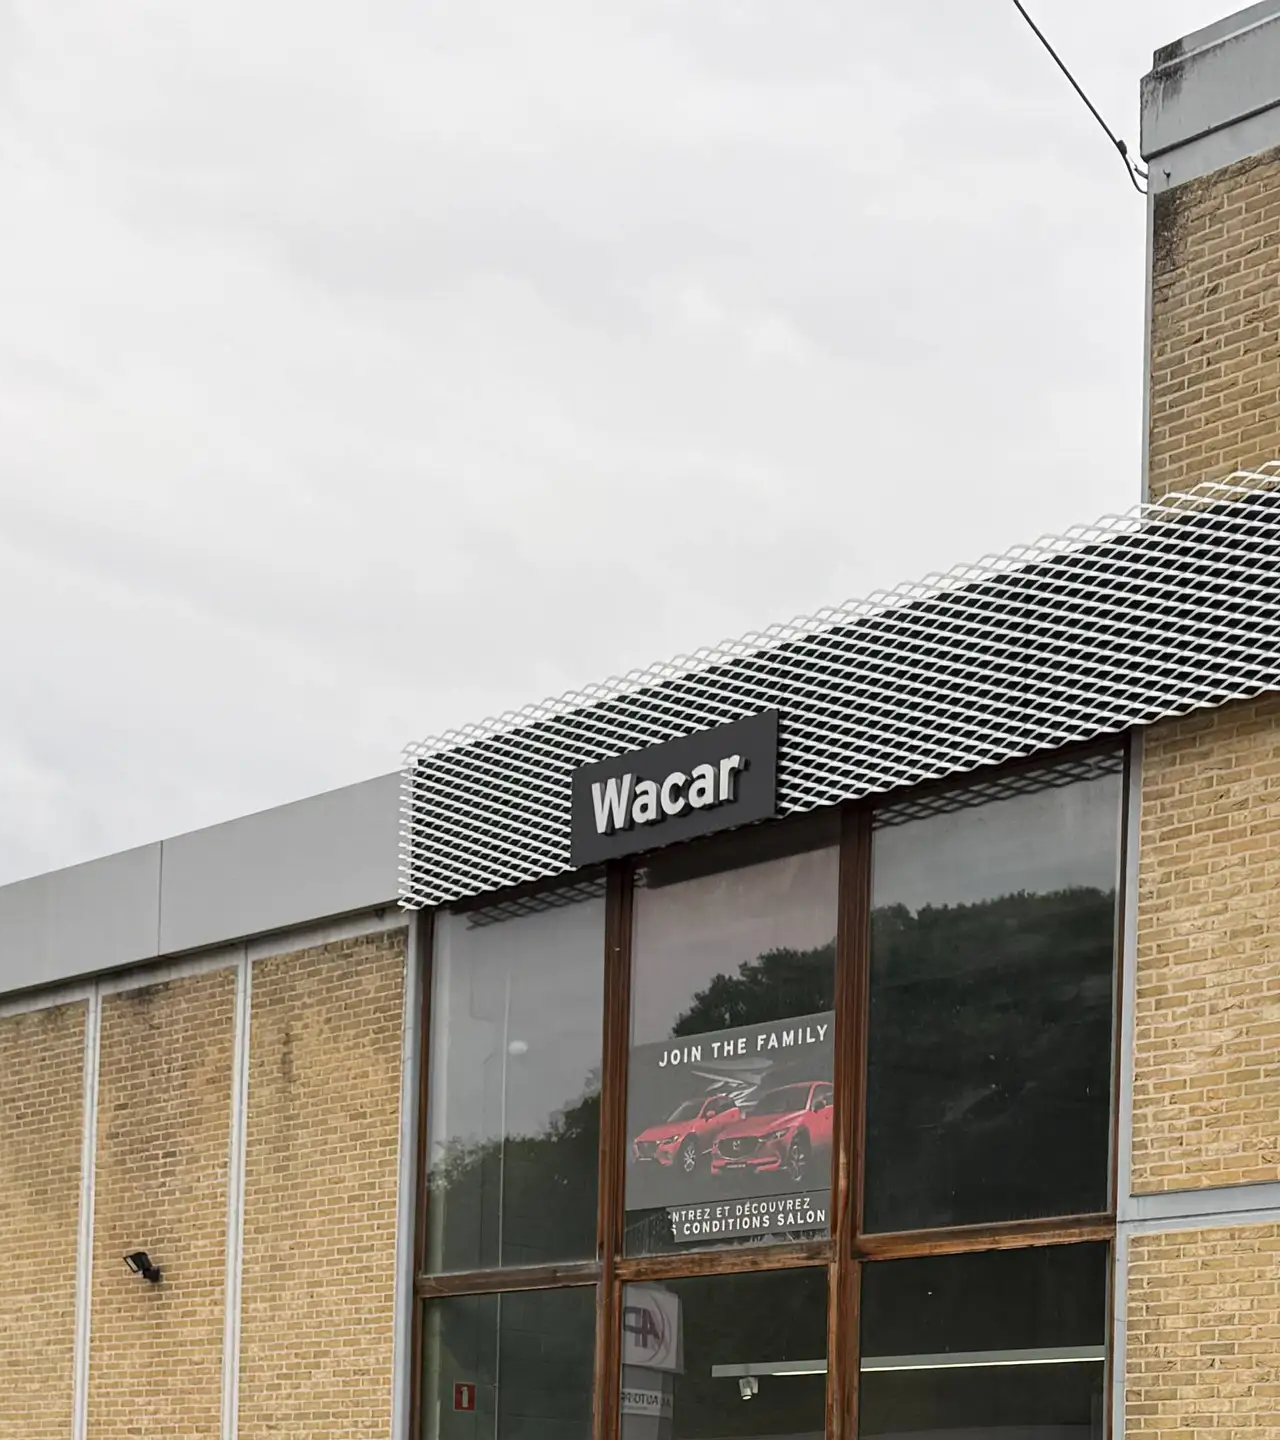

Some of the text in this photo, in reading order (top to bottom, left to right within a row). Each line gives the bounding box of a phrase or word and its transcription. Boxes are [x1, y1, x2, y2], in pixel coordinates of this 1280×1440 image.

[591, 754, 744, 834] Wacar
[658, 1024, 828, 1068] JOIN THE FAMILY
[668, 1197, 811, 1223] NTREZ ET DÉCOUVREZ
[683, 1214, 770, 1236] CONDITIONS
[777, 1209, 826, 1226] SALON
